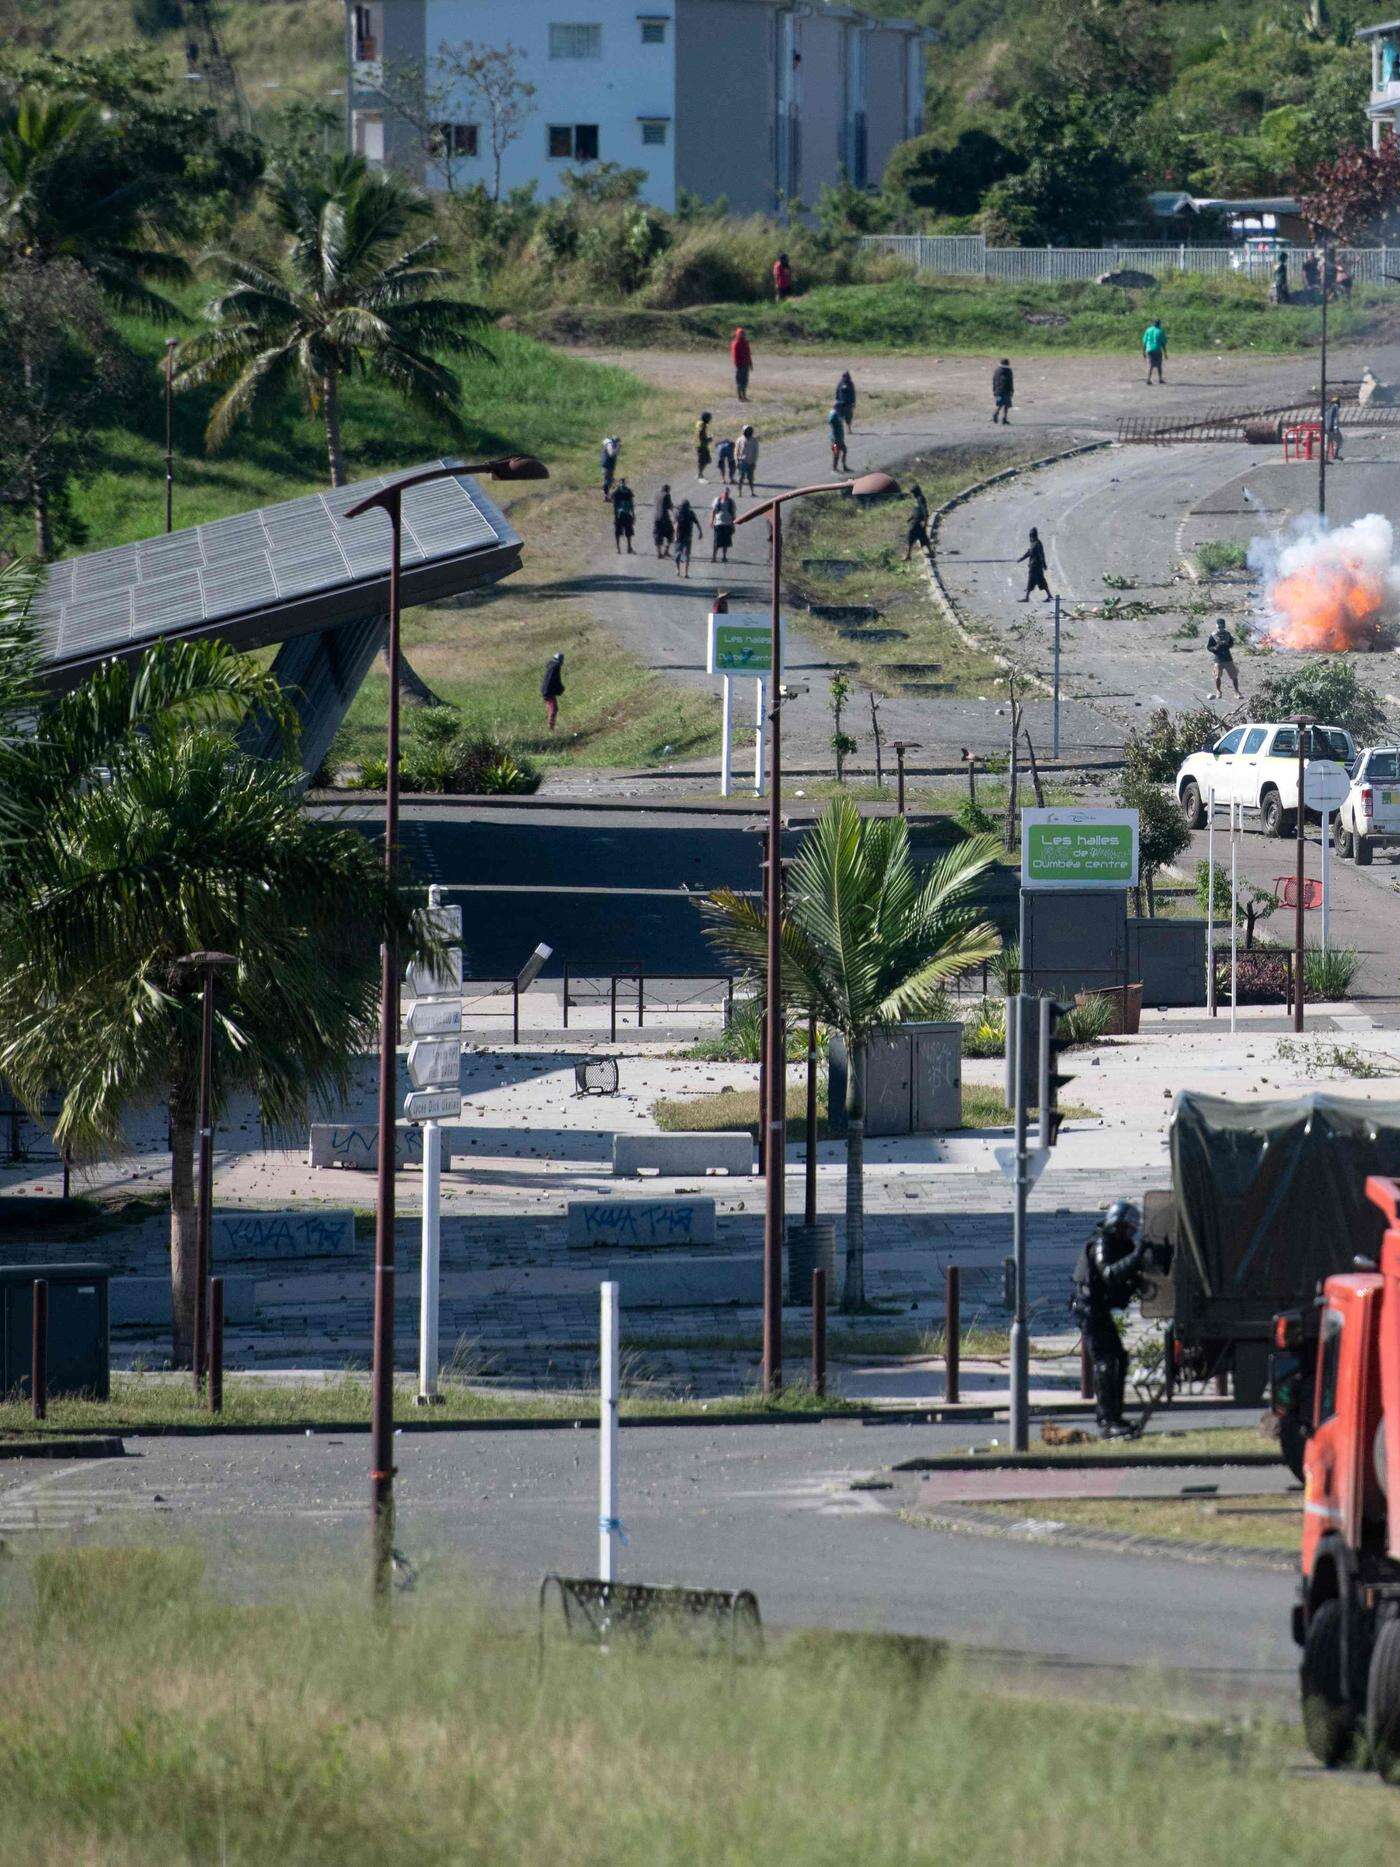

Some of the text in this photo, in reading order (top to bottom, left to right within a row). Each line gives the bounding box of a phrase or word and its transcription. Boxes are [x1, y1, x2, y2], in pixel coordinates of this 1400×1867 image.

[1041, 835, 1120, 845] Les halles
[1073, 849, 1089, 857] de
[1085, 858, 1128, 868] centre
